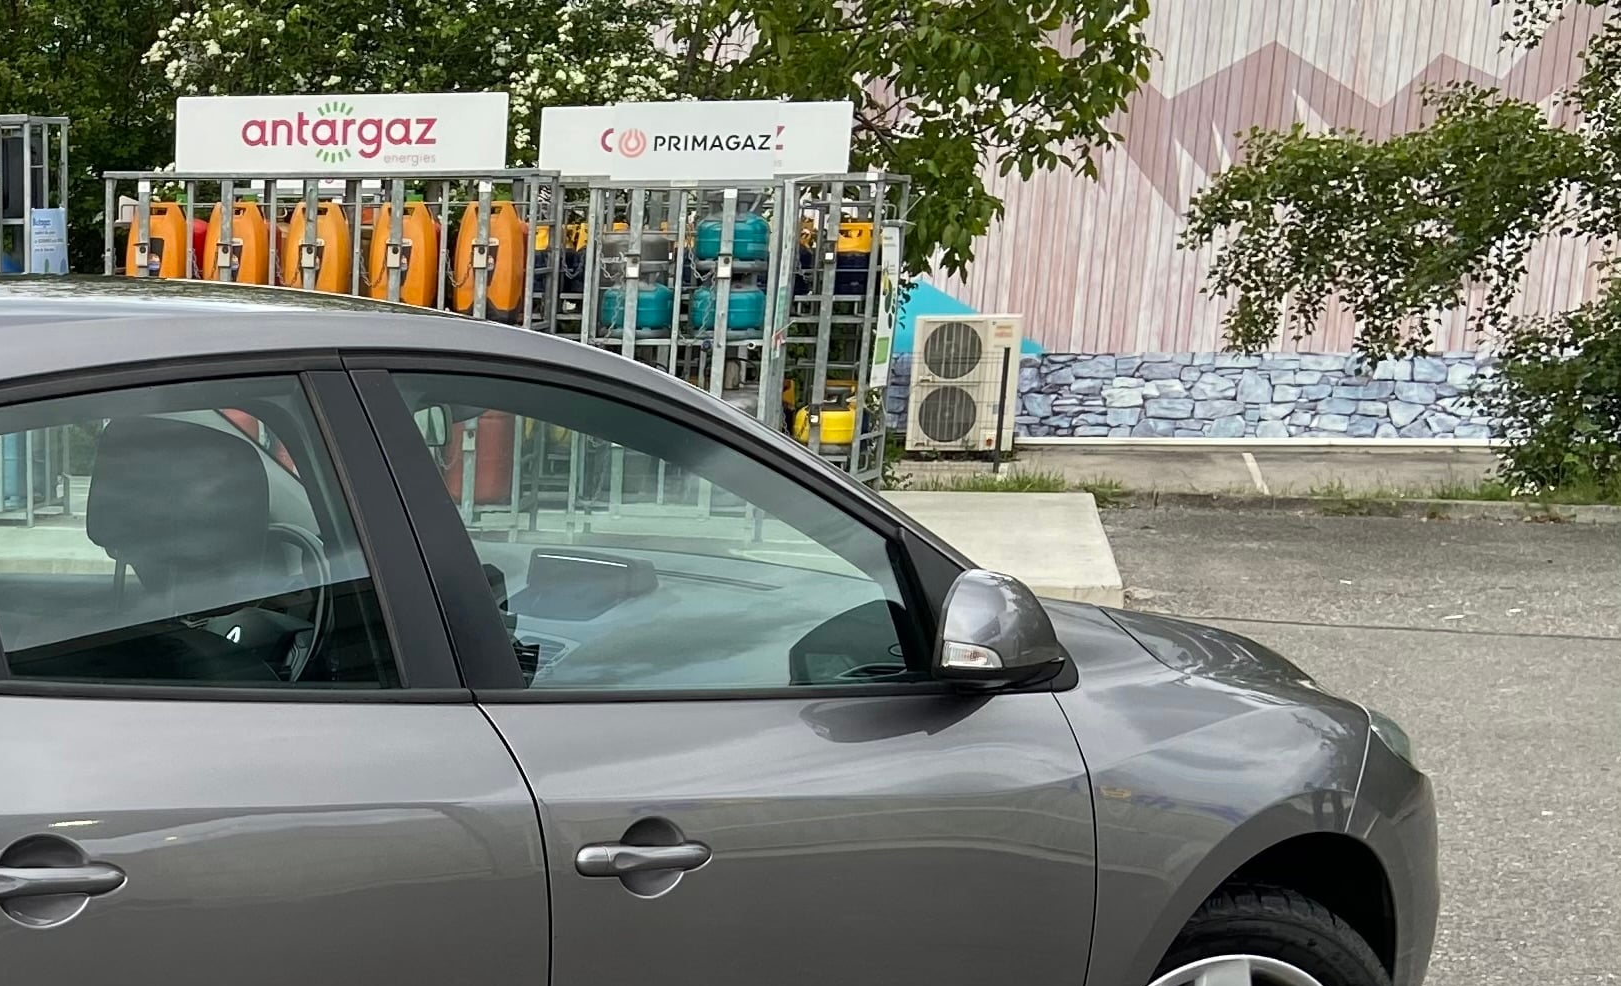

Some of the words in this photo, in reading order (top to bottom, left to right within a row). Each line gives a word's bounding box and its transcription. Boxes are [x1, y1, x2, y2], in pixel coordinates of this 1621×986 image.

[242, 112, 437, 158] antargaz
[653, 134, 772, 151] PRIMAGAZ
[383, 152, 436, 166] energies
